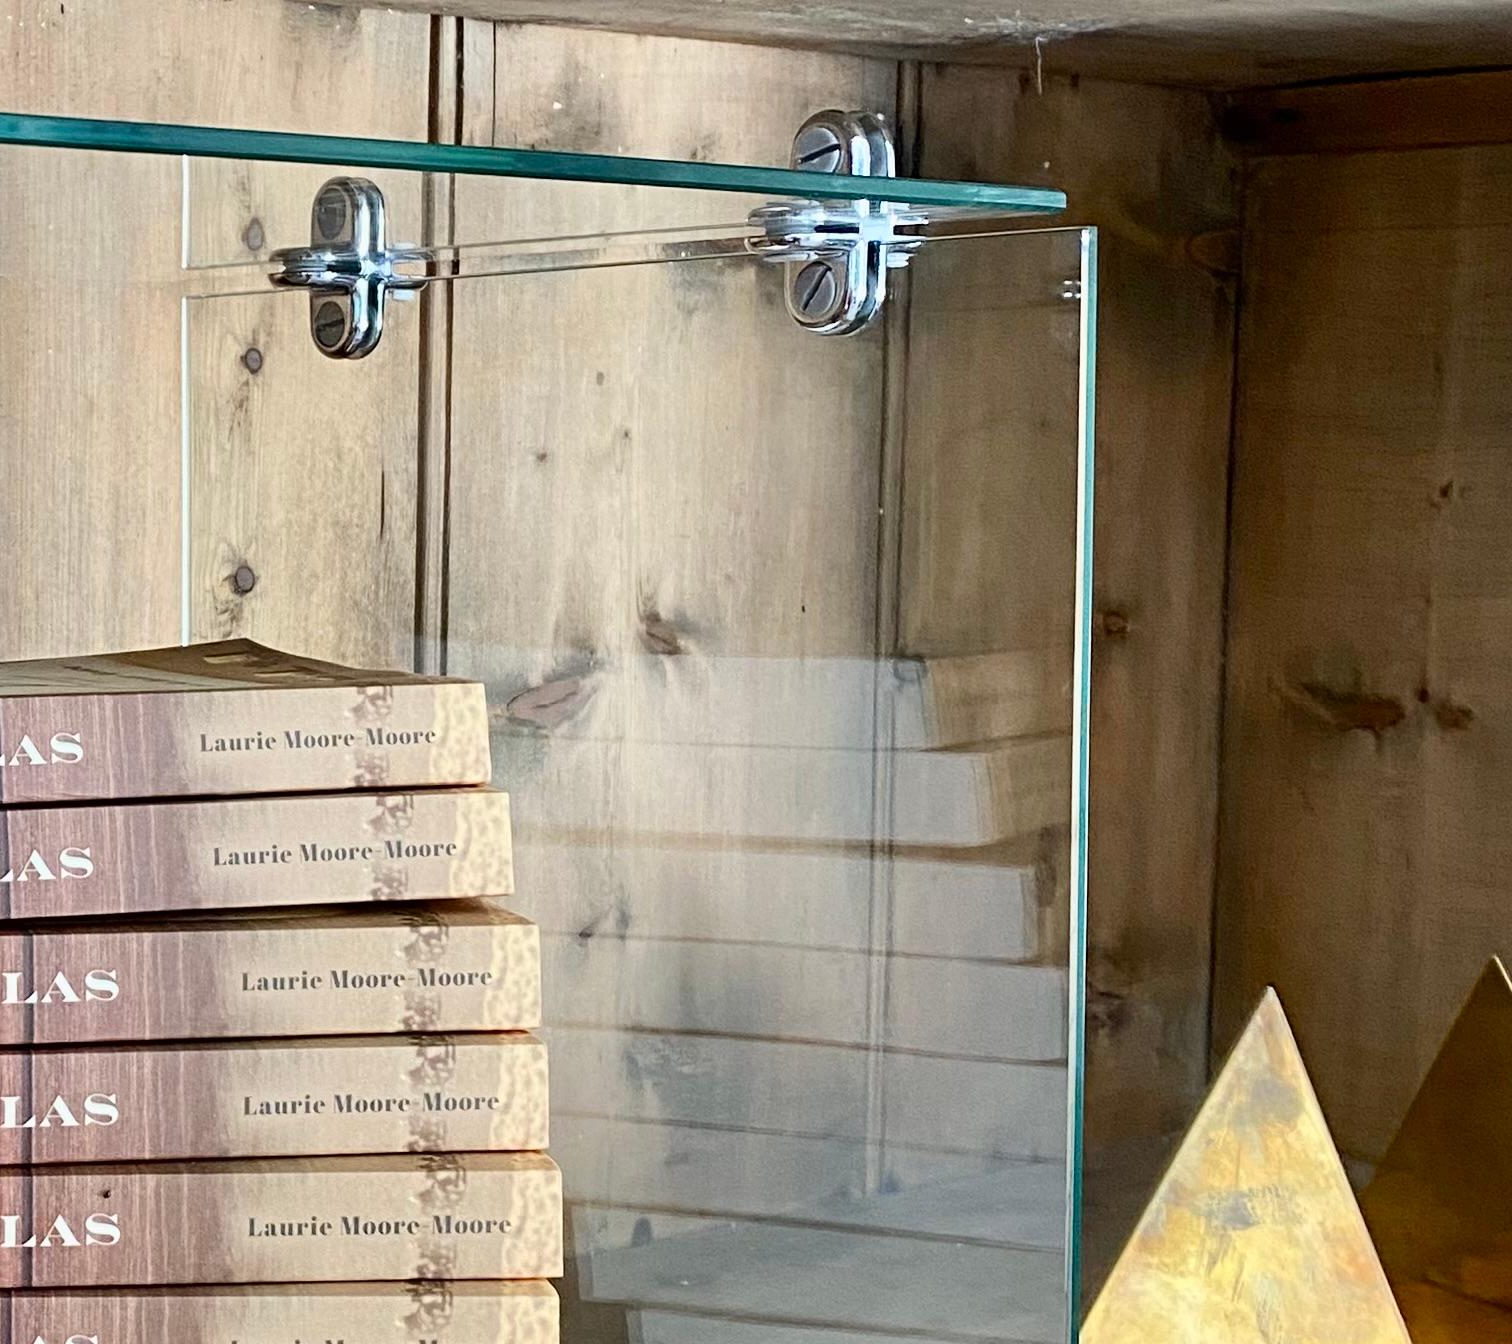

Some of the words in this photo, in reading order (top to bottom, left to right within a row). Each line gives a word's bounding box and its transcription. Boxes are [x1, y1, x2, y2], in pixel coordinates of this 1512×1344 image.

[200, 731, 277, 752] Laurie
[284, 727, 436, 749] Moore-Moore
[213, 844, 292, 867] Laurie
[300, 840, 457, 862] Moore-Moore
[242, 970, 323, 991] Laurie
[330, 967, 492, 989] Moore-Moore
[244, 1094, 326, 1116] Laurie
[334, 1092, 499, 1113] Moore-Moore
[248, 1215, 333, 1237] Laurie
[341, 1215, 512, 1235] Moore-Moore
